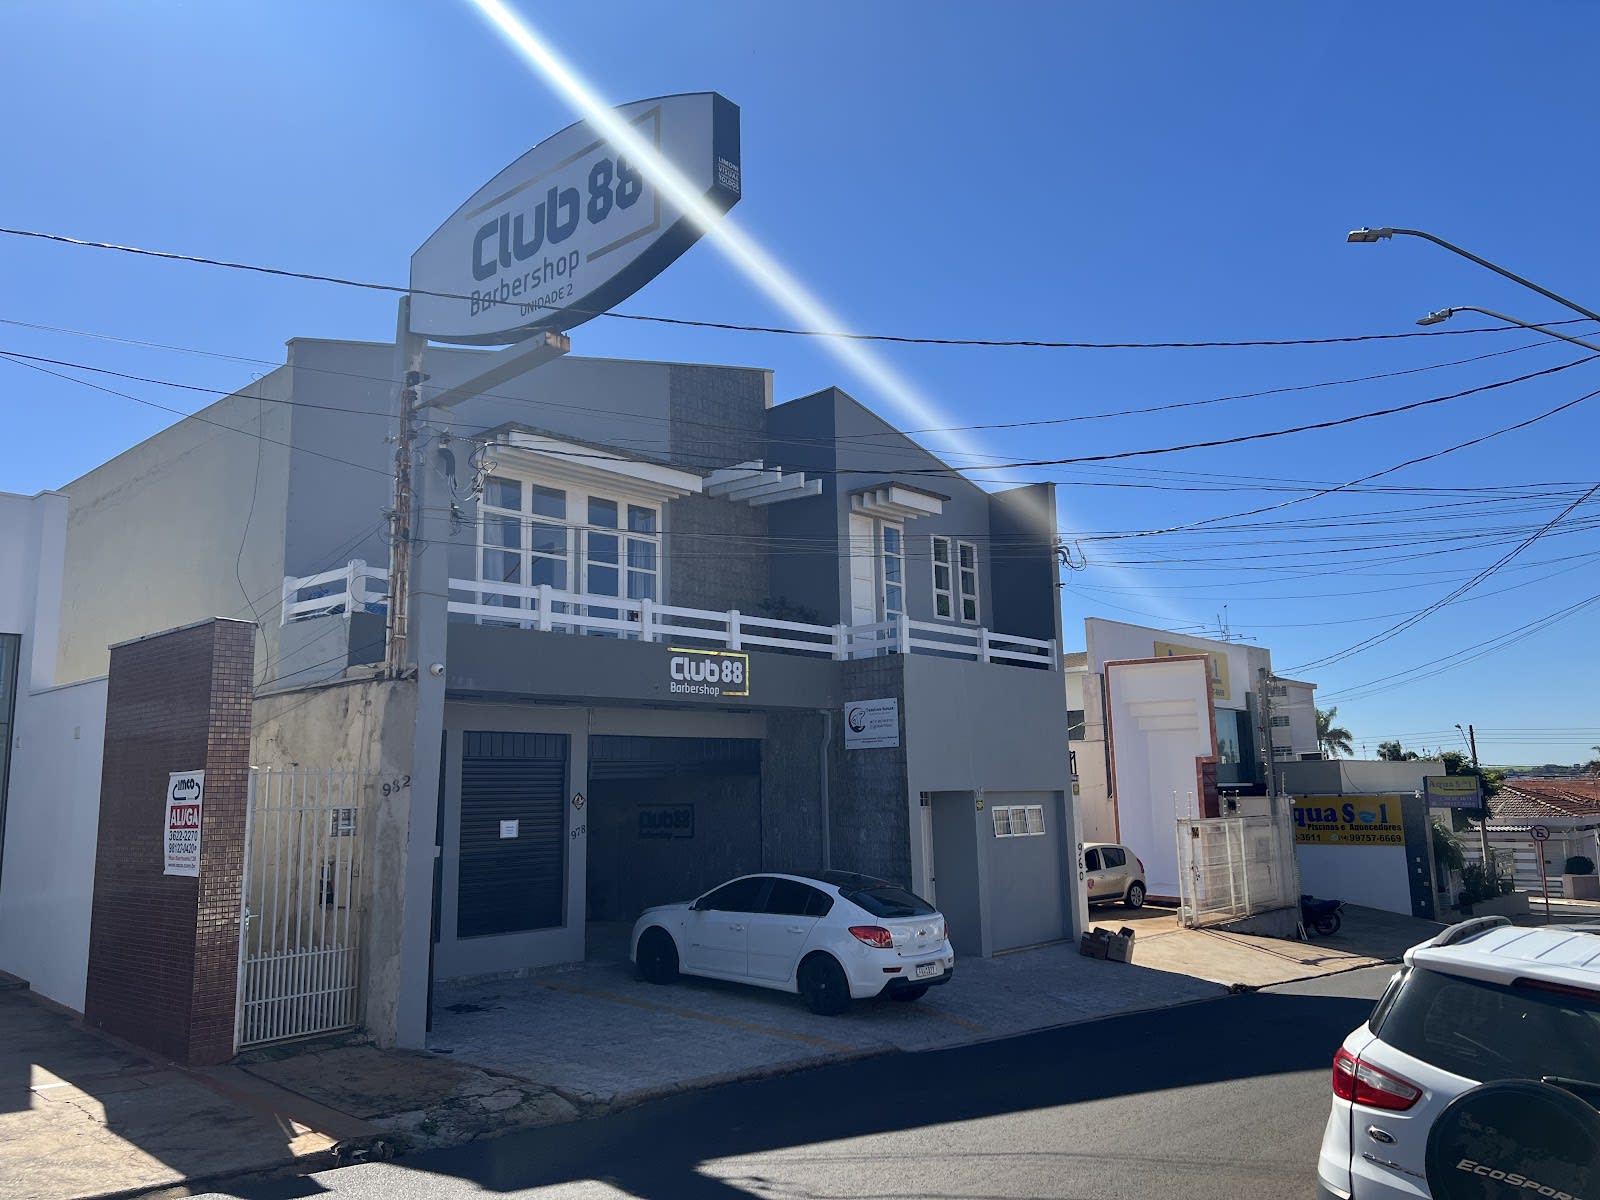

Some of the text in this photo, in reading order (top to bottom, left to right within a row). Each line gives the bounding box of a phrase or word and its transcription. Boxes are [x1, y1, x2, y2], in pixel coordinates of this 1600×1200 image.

[472, 153, 643, 282] Club 88
[470, 249, 580, 317] Barbershop
[520, 282, 574, 317] UNIDADE 2
[670, 656, 743, 684] Club 88
[670, 682, 720, 697] Barbershop
[170, 808, 198, 826] ALUGA
[1293, 807, 1338, 828] qua
[571, 824, 586, 840] 978
[1456, 1158, 1583, 1200] ECOSPOR
